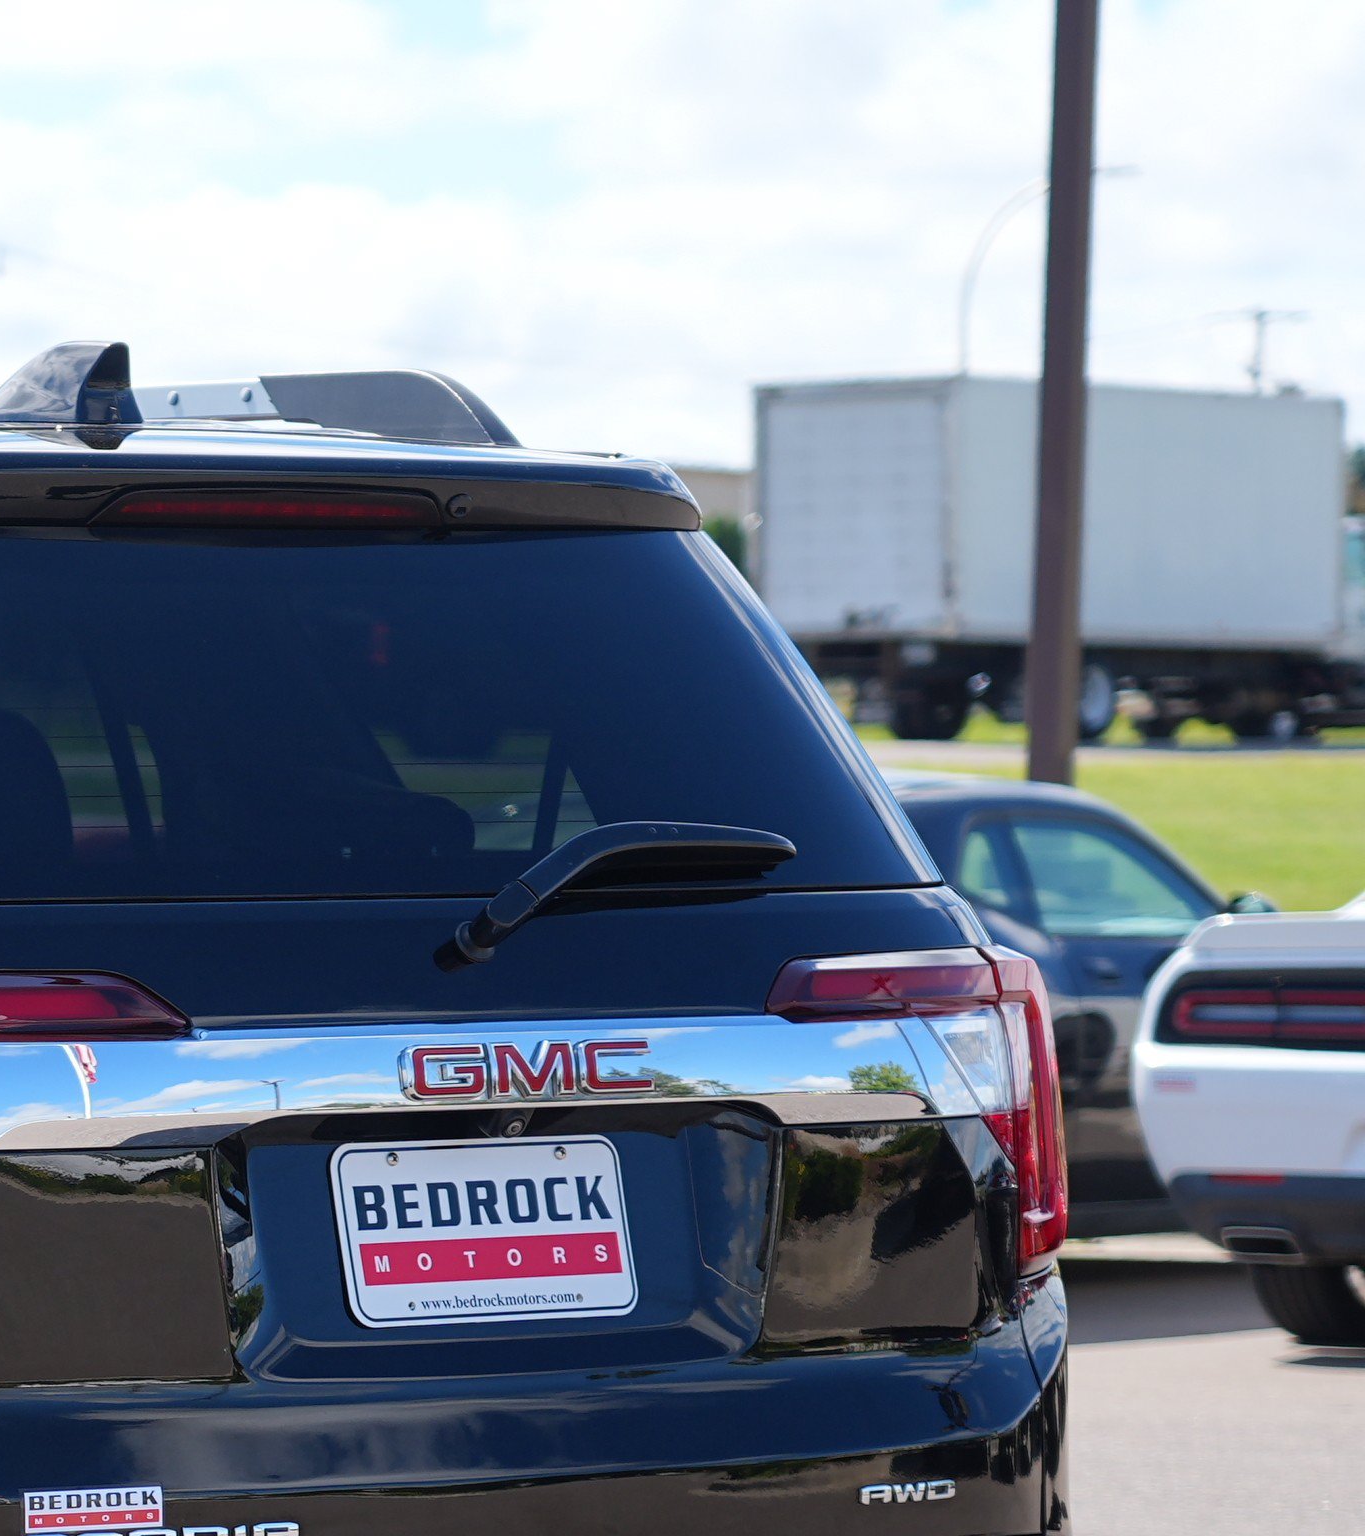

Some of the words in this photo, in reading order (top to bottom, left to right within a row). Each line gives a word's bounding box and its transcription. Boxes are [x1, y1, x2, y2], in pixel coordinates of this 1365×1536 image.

[397, 1037, 655, 1100] GMC
[352, 1175, 613, 1231] BEDROCK
[374, 1244, 608, 1273] MOTORS
[420, 1291, 576, 1311] www.bedrockmotors.com
[28, 1489, 158, 1511] BEDROCK
[858, 1478, 956, 1506] AWD
[34, 1512, 154, 1526] MOTORS
